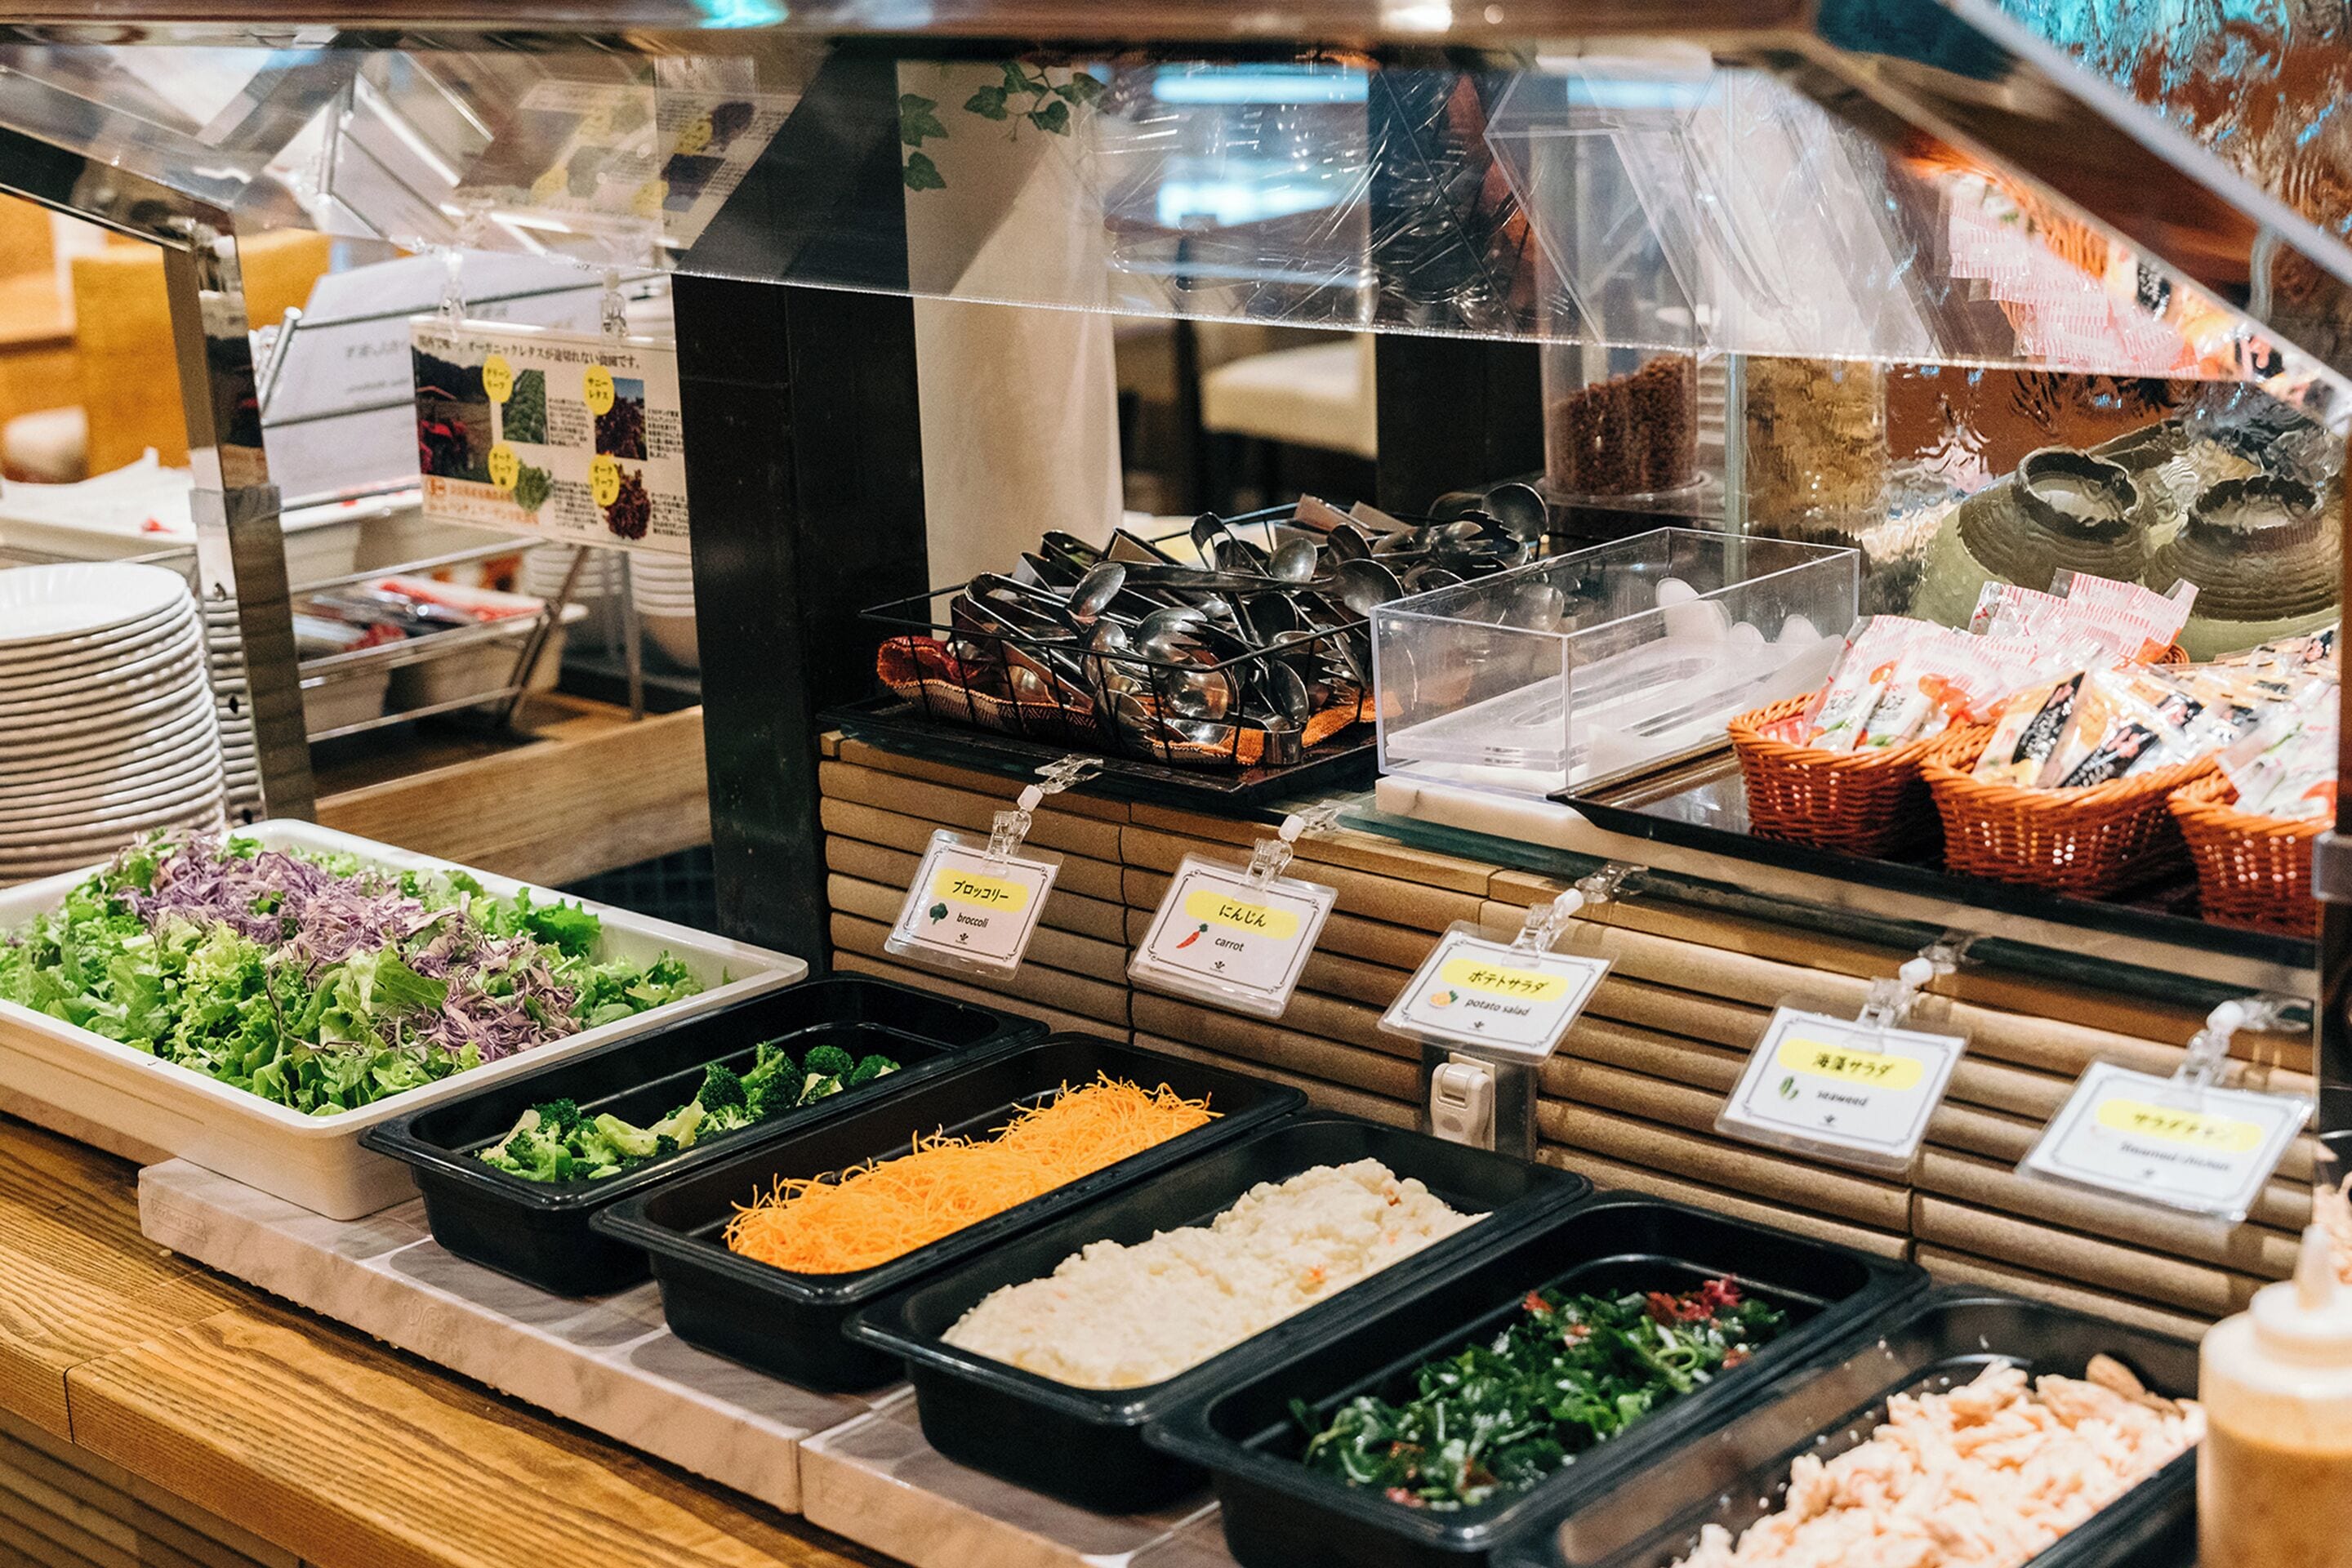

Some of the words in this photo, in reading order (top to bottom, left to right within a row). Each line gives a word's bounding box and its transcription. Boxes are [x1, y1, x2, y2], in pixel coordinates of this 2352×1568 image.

[952, 880, 1009, 902] ブロッコリー
[956, 912, 990, 929] broccoli
[1218, 904, 1267, 928] にんじん
[1214, 937, 1245, 953] carrot
[1468, 970, 1550, 994] ポテトサラダ
[1464, 998, 1501, 1012] potato
[1502, 1004, 1532, 1017] salad
[1817, 1090, 1870, 1107] seaweed
